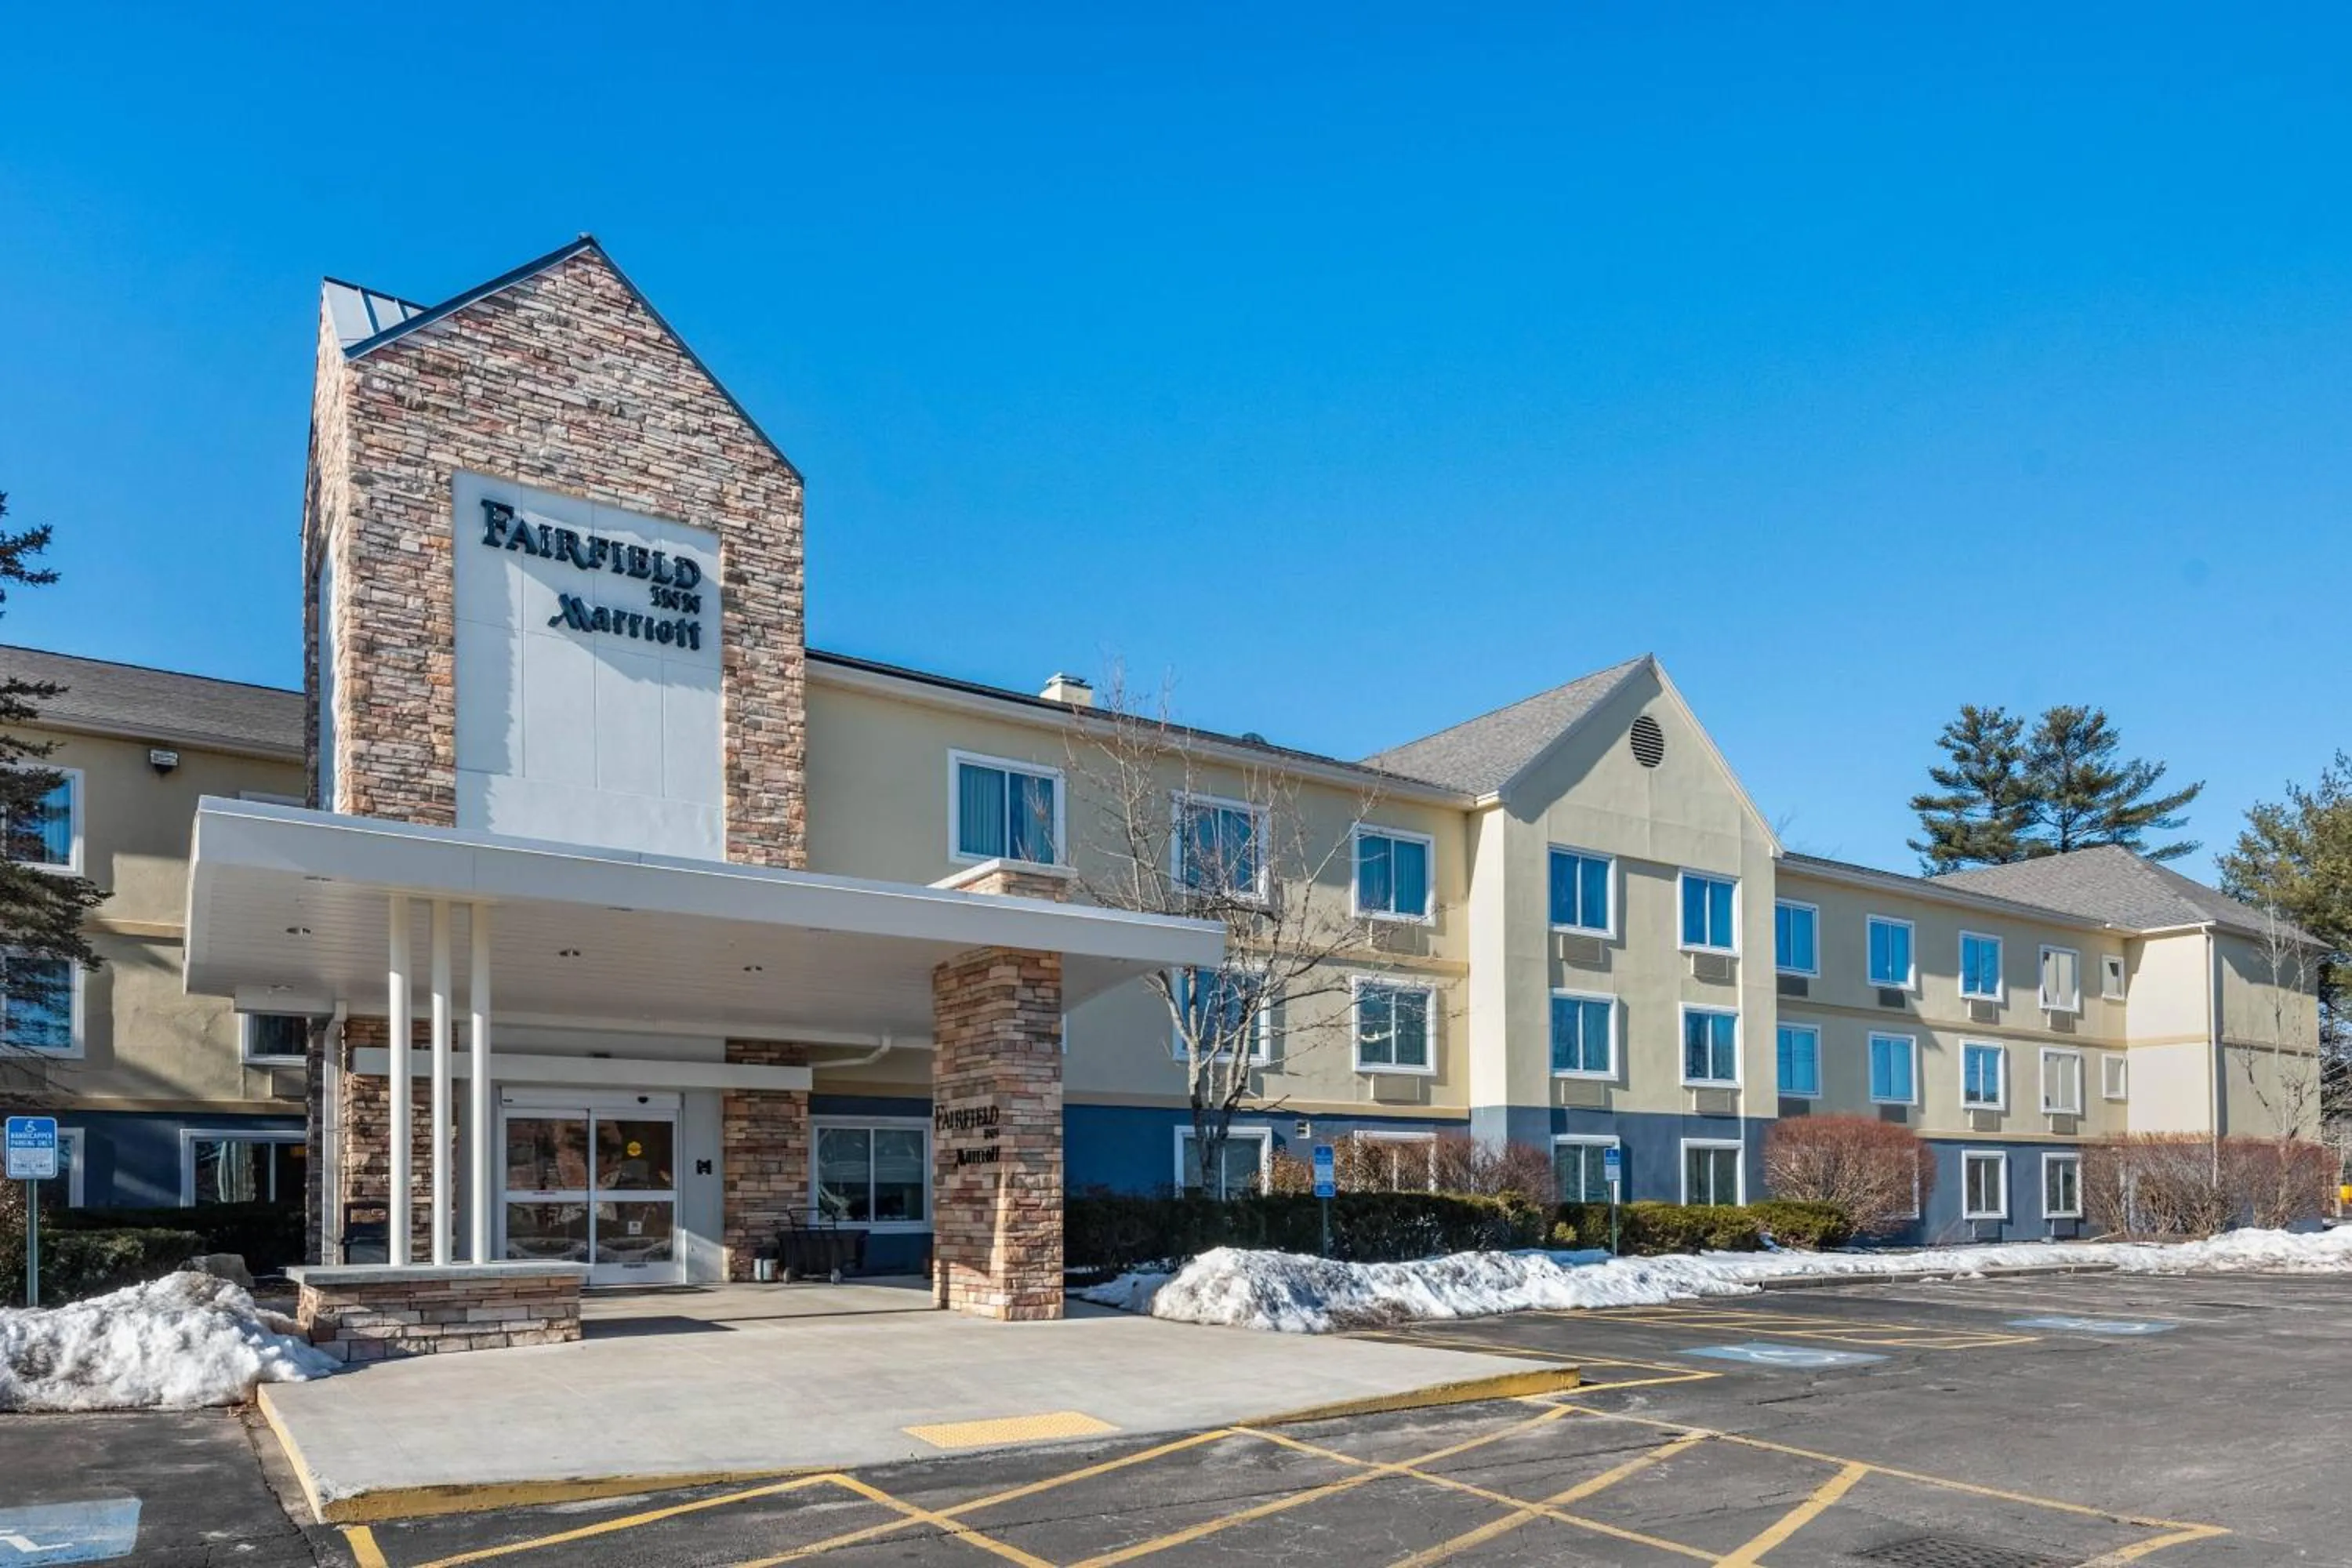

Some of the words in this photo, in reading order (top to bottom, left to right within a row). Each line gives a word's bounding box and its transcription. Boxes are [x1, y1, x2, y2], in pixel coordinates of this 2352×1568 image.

[481, 499, 702, 590] FAIRFIELD
[650, 586, 702, 615] INN
[548, 593, 701, 651] Marriott
[935, 1105, 1000, 1131] FAIRFIELD
[953, 1145, 1000, 1168] Marriott
